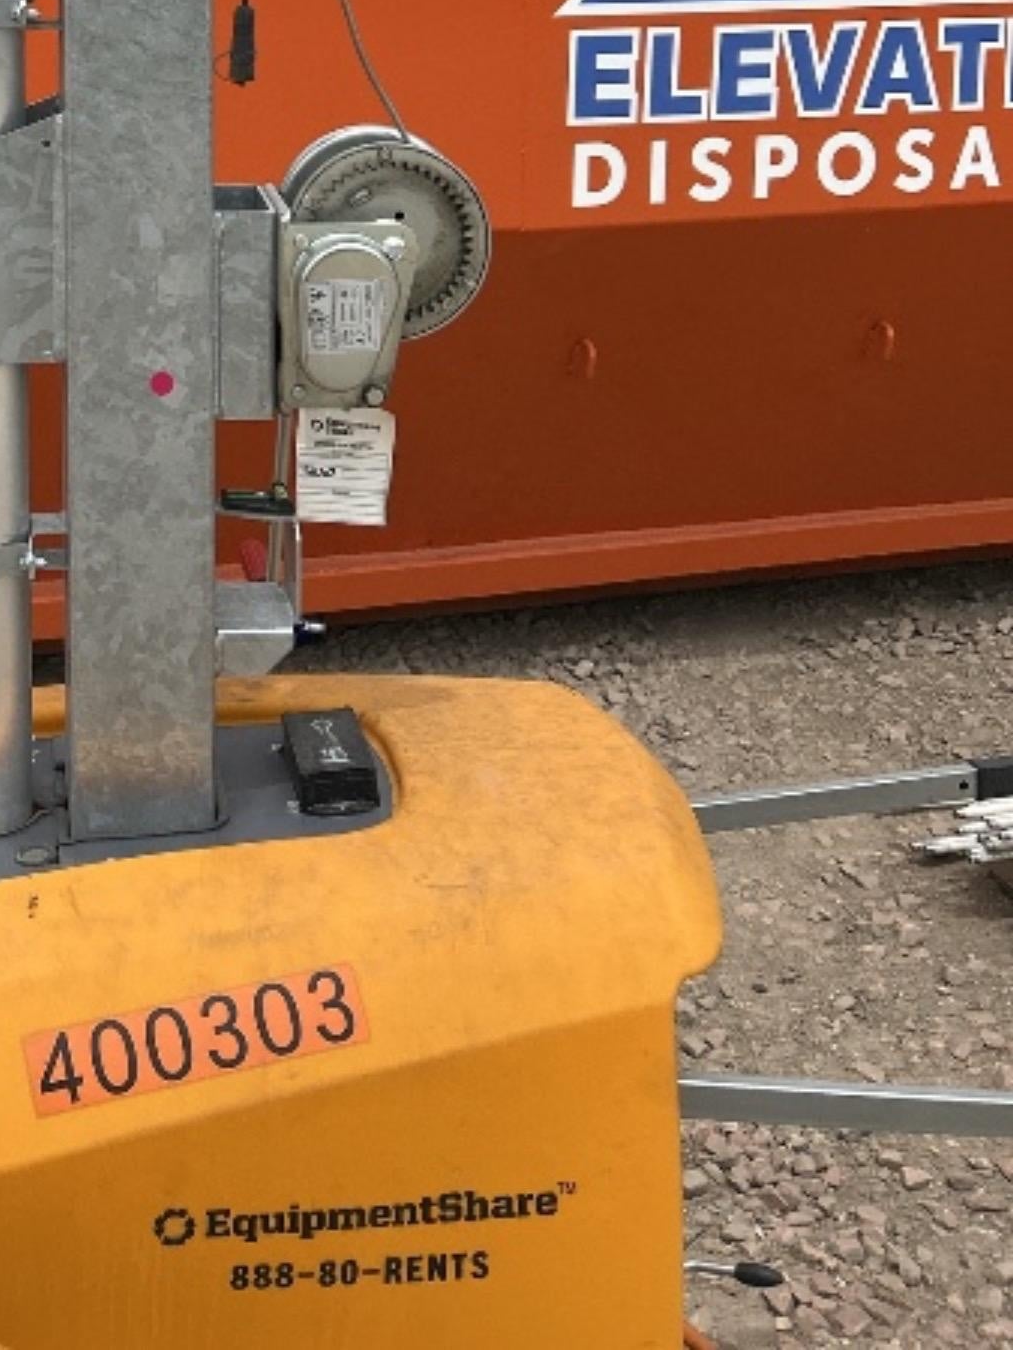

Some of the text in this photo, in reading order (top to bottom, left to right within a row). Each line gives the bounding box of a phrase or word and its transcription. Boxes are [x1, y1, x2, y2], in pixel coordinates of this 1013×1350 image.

[565, 16, 1013, 127] ELEVAT
[570, 125, 1002, 209] DISPOSA
[39, 970, 356, 1105] 400303
[204, 1190, 558, 1244] EquipmentShare
[229, 1250, 490, 1291] 888-80-RENTS
